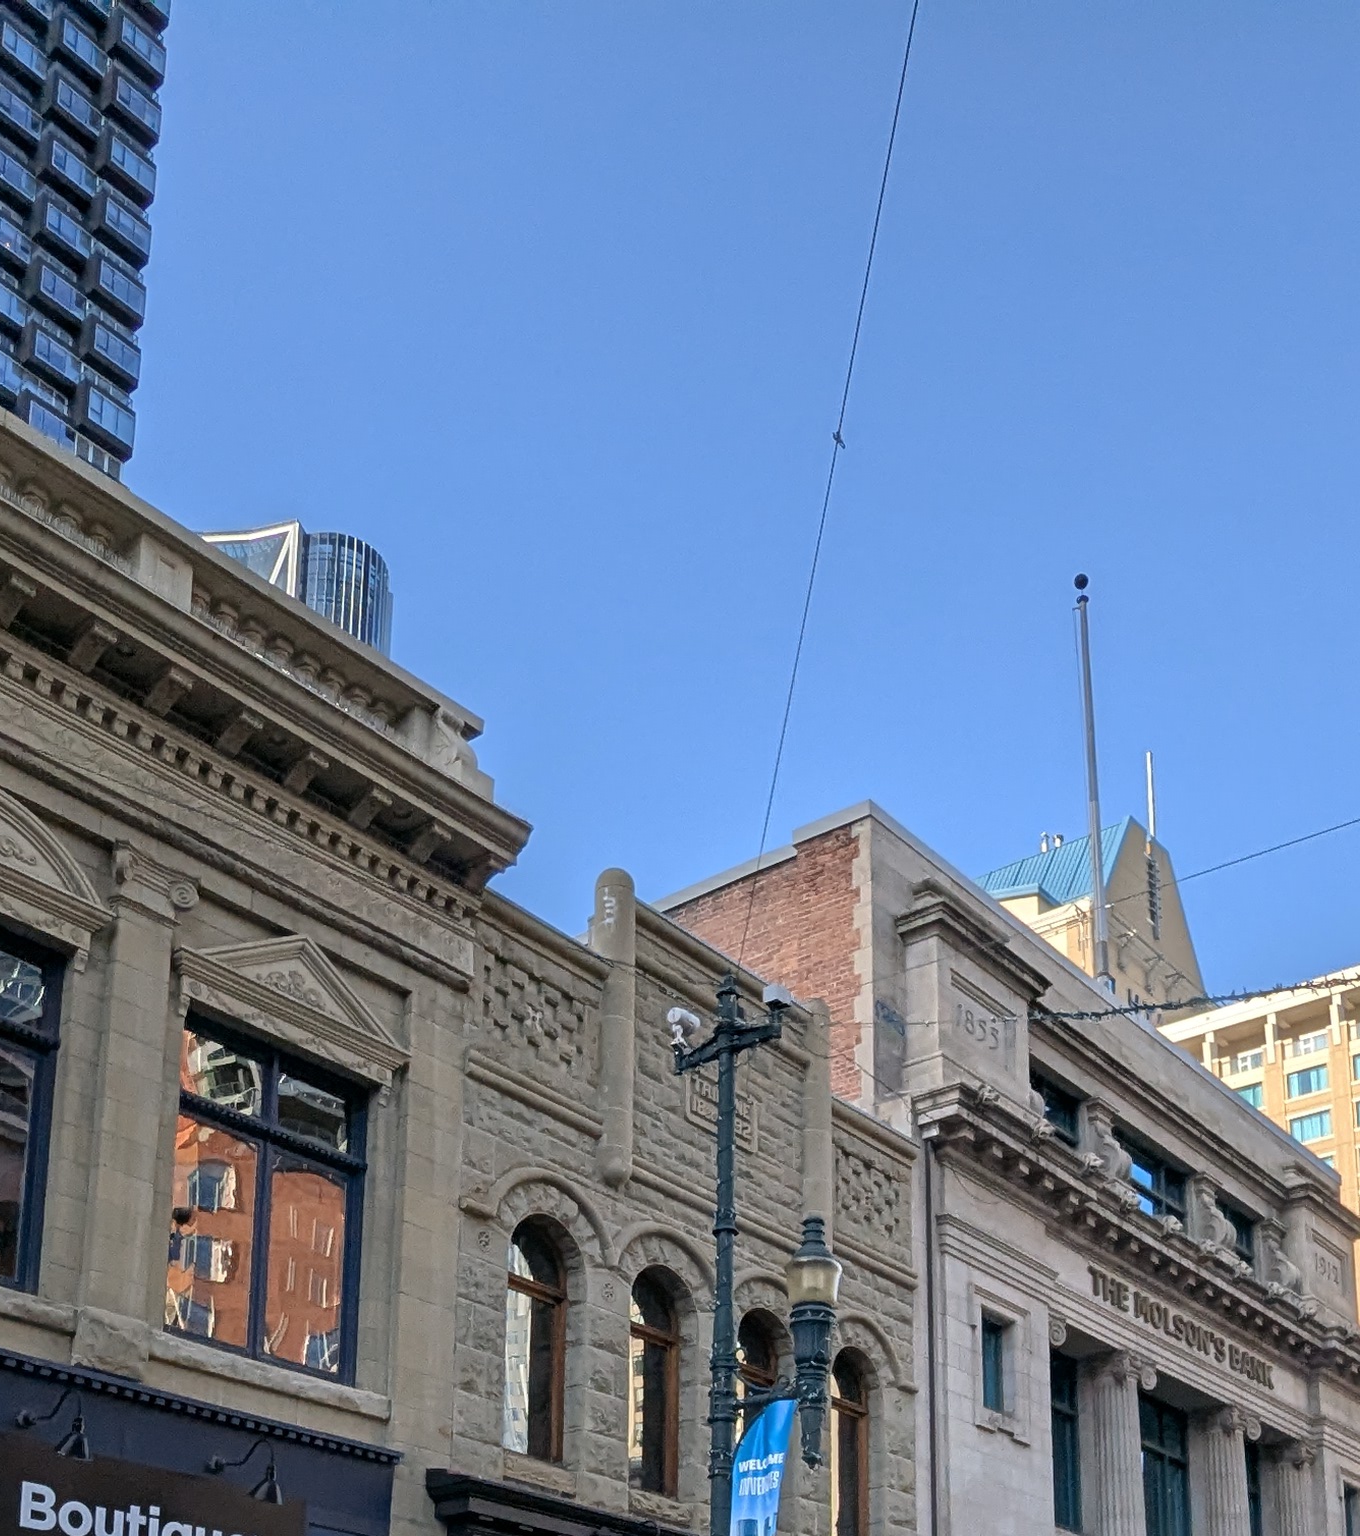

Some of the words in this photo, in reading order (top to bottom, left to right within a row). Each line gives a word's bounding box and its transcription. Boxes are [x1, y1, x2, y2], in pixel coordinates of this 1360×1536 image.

[1087, 1265, 1130, 1312] THE
[1133, 1291, 1227, 1363] MOLSON'S
[1229, 1344, 1275, 1390] BANK
